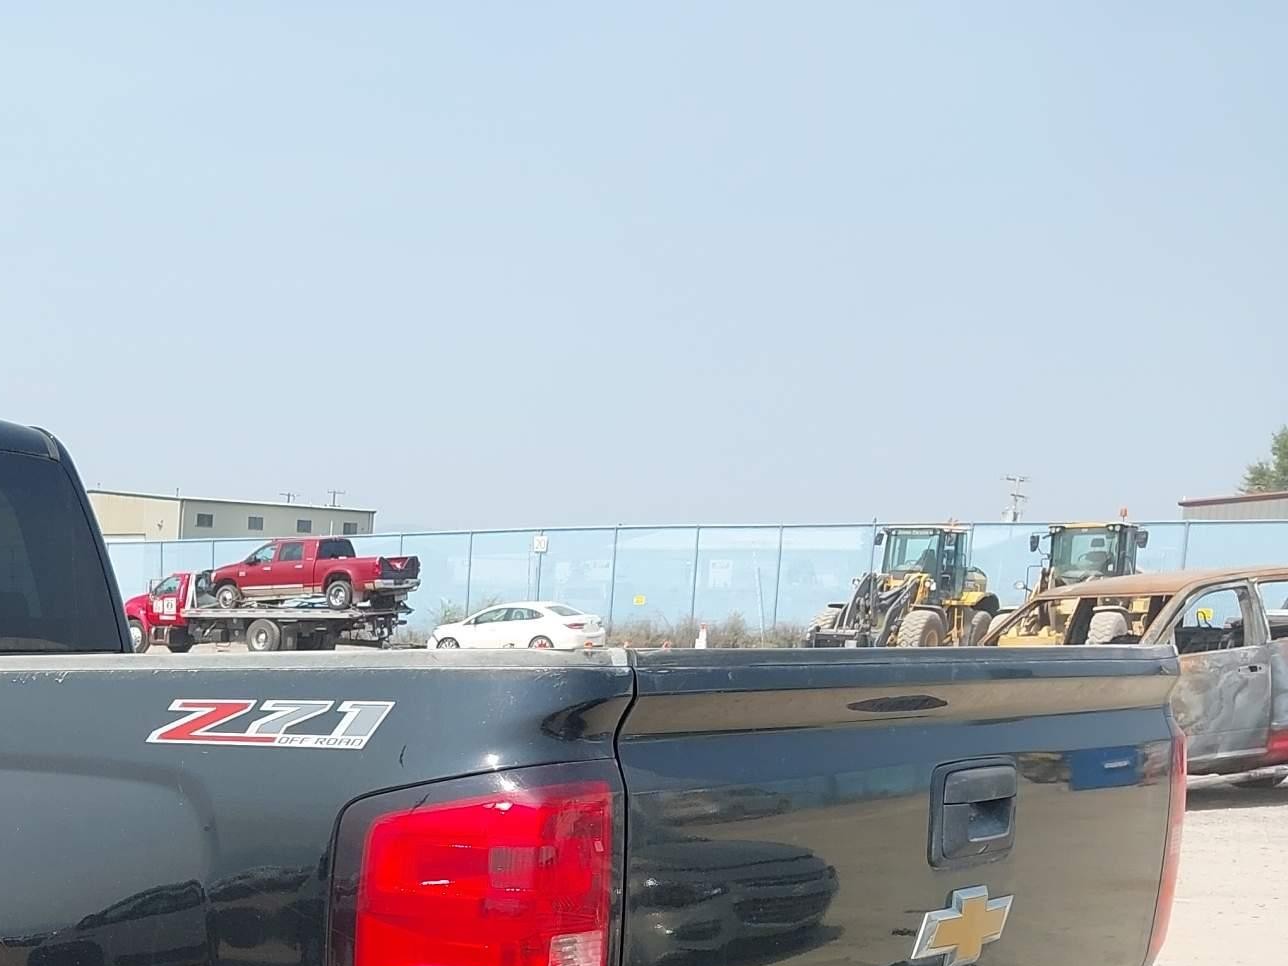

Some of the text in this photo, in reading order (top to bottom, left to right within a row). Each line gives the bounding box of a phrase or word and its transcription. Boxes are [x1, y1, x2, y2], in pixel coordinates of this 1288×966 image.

[146, 699, 396, 748] Z71
[277, 735, 364, 747] OFF ROAD
